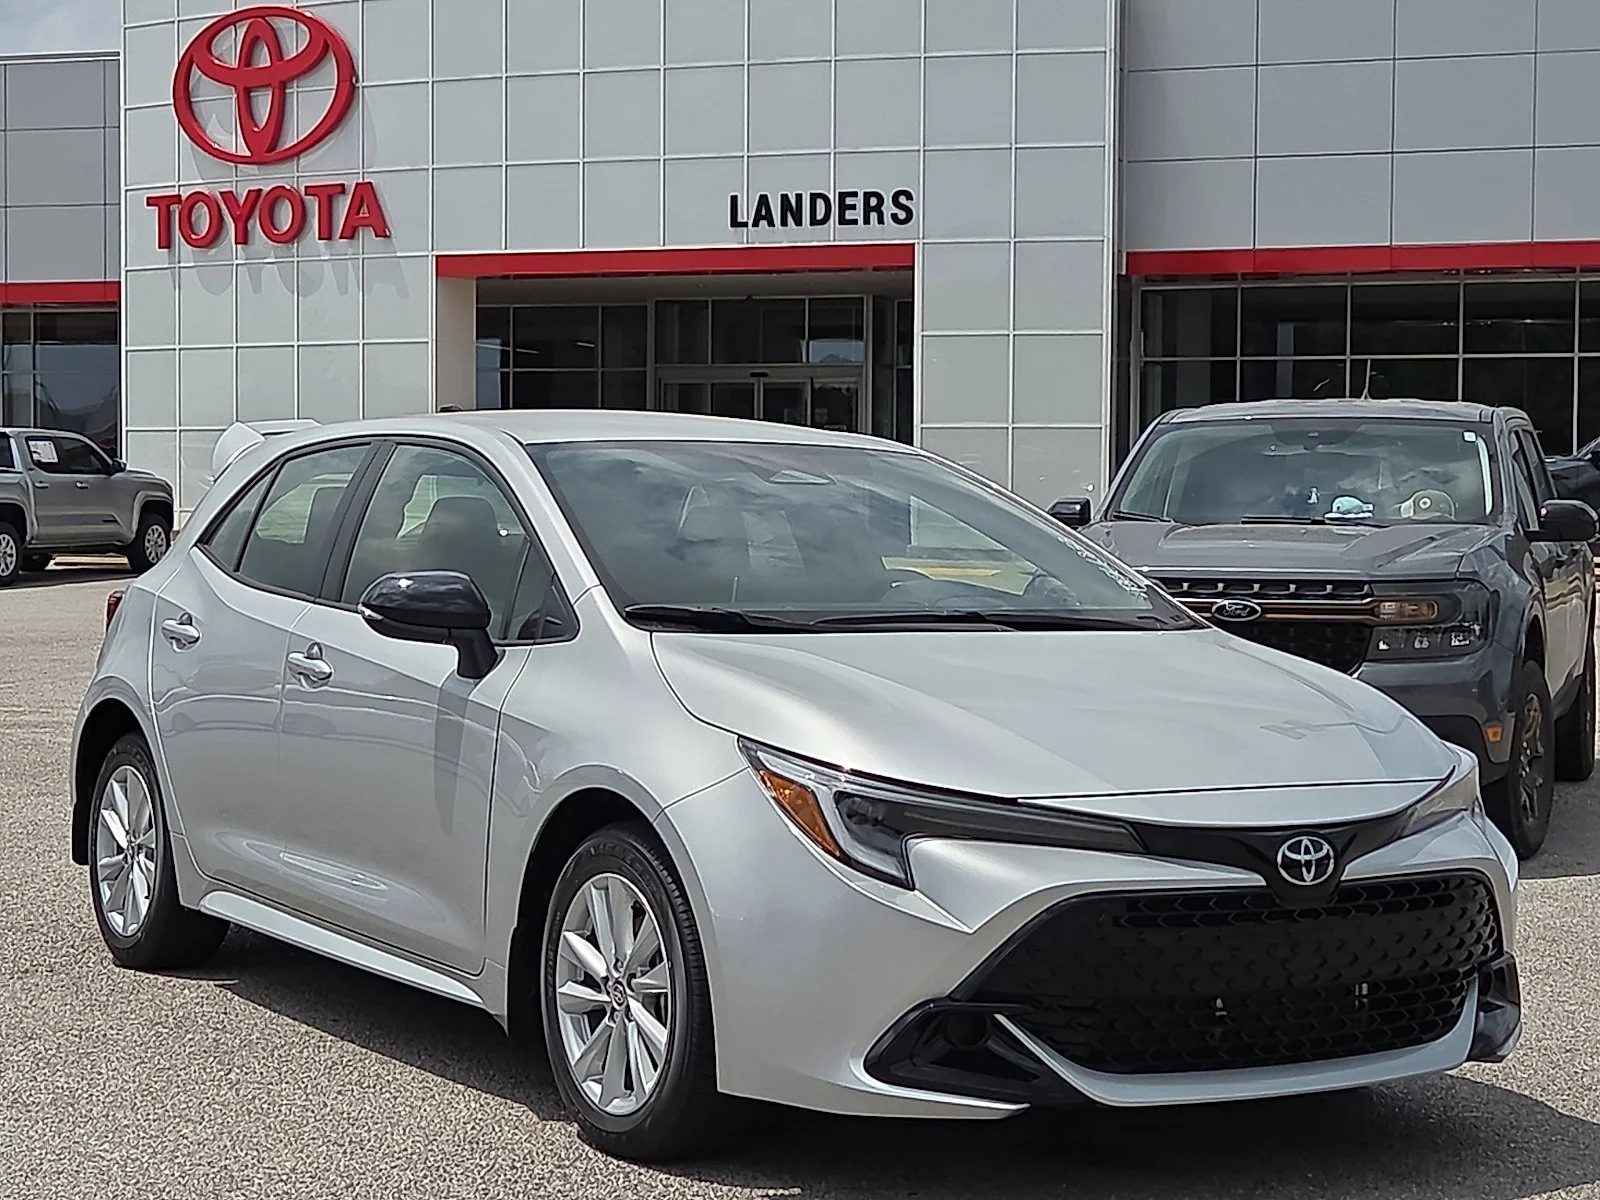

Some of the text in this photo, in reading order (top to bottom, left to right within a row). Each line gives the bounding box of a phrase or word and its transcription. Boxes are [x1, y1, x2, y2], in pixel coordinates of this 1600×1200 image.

[146, 181, 390, 249] TOYOTA
[729, 188, 914, 228] LANDERS
[1220, 602, 1252, 618] Ford
